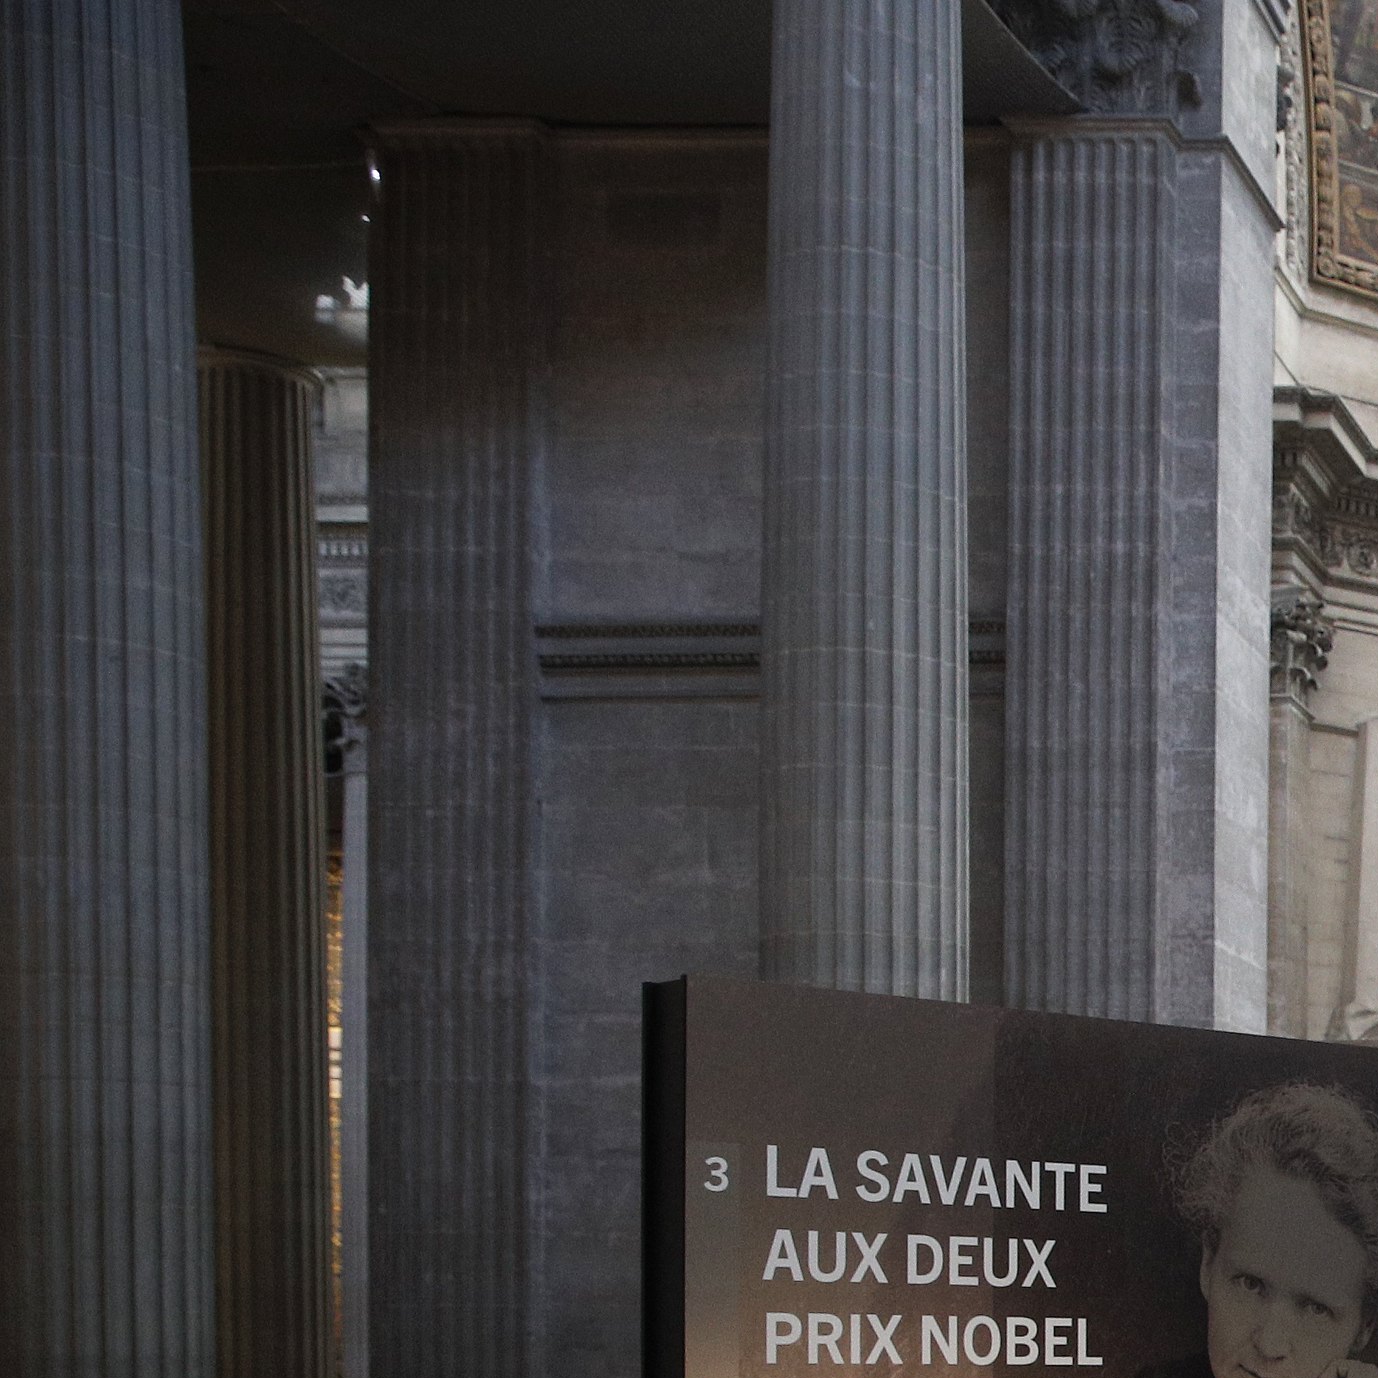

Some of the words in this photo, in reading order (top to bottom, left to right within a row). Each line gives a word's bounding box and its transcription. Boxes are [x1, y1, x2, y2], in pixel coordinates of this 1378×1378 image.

[704, 1156, 729, 1193] 3
[766, 1144, 839, 1200] LA
[855, 1150, 1108, 1213] SAVANTE
[762, 1229, 889, 1284] AUX
[907, 1234, 1057, 1288] DEUX
[765, 1312, 903, 1365] PRIX
[921, 1315, 1104, 1366] NOBEL
